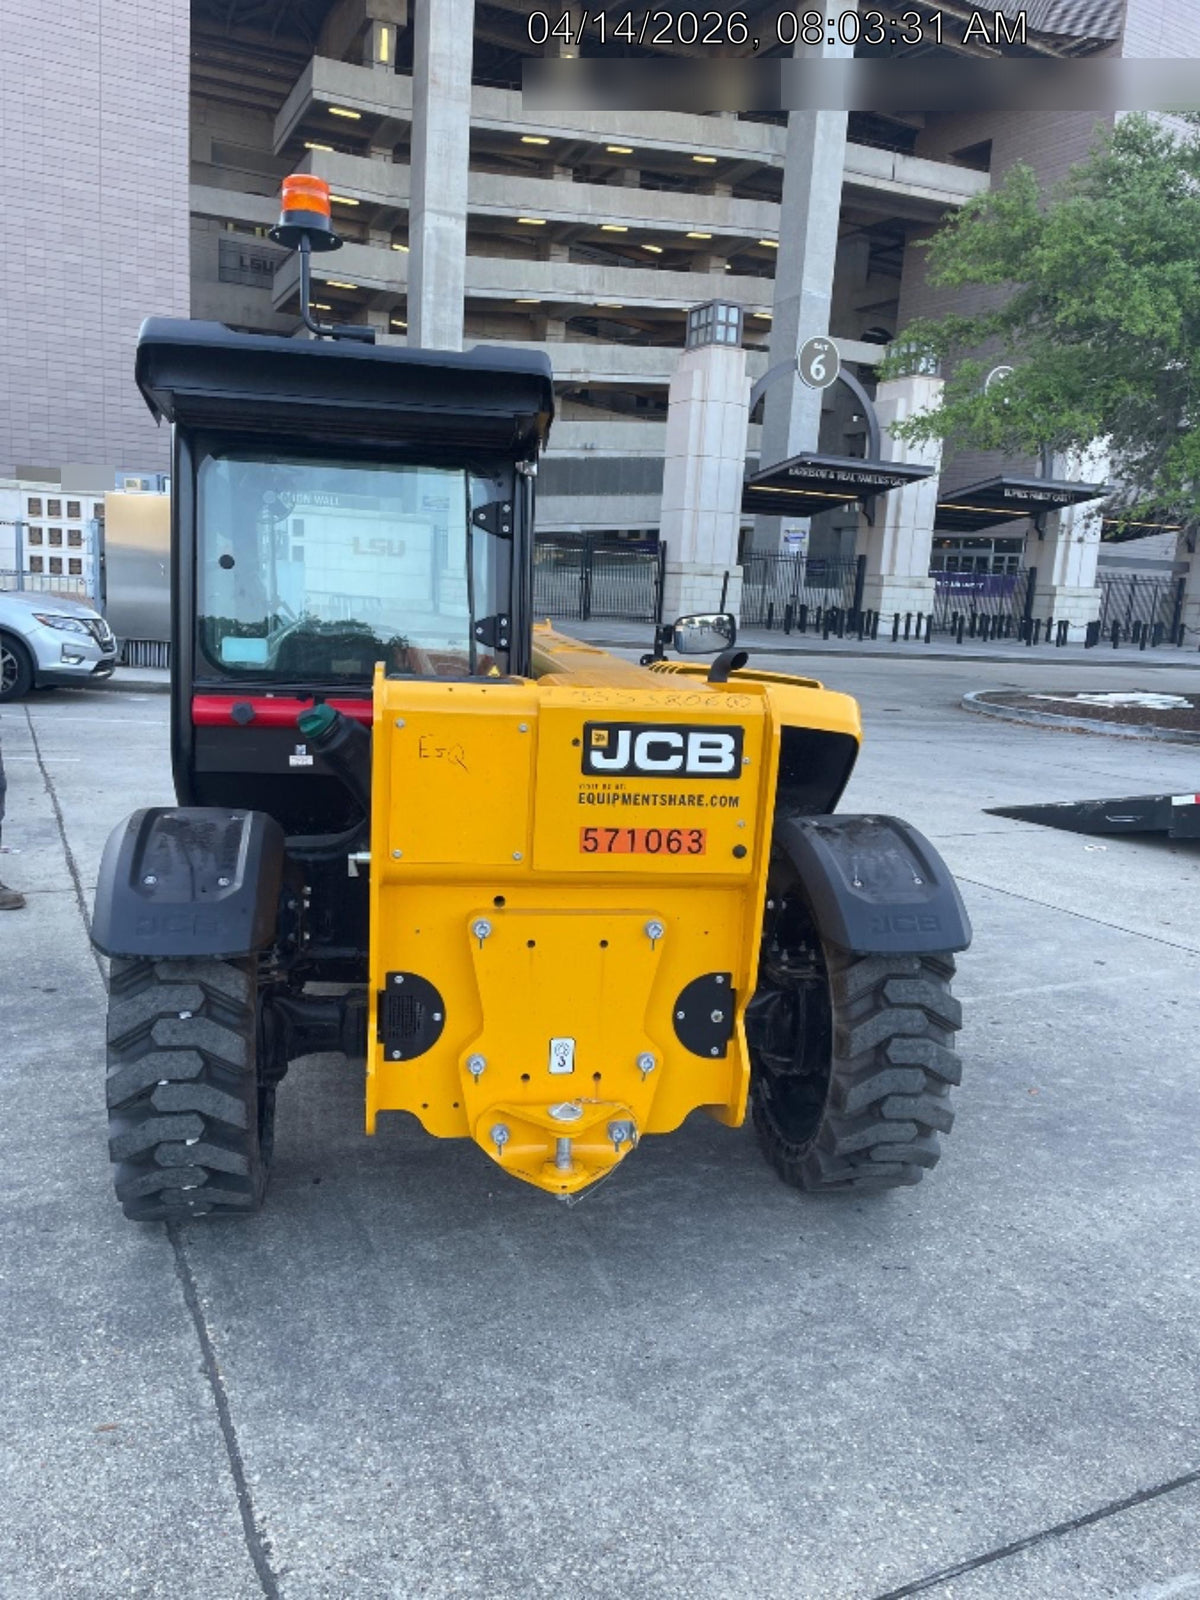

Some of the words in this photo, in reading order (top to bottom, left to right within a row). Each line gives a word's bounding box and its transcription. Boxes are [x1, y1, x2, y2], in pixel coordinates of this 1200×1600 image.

[810, 353, 826, 381] 6
[352, 536, 406, 557] LSU
[590, 730, 735, 773] JCB
[578, 792, 740, 808] EQUIPMENTSHARE.COM
[582, 827, 703, 854] 571063
[869, 912, 943, 935] JCB
[557, 1055, 567, 1068] 3
